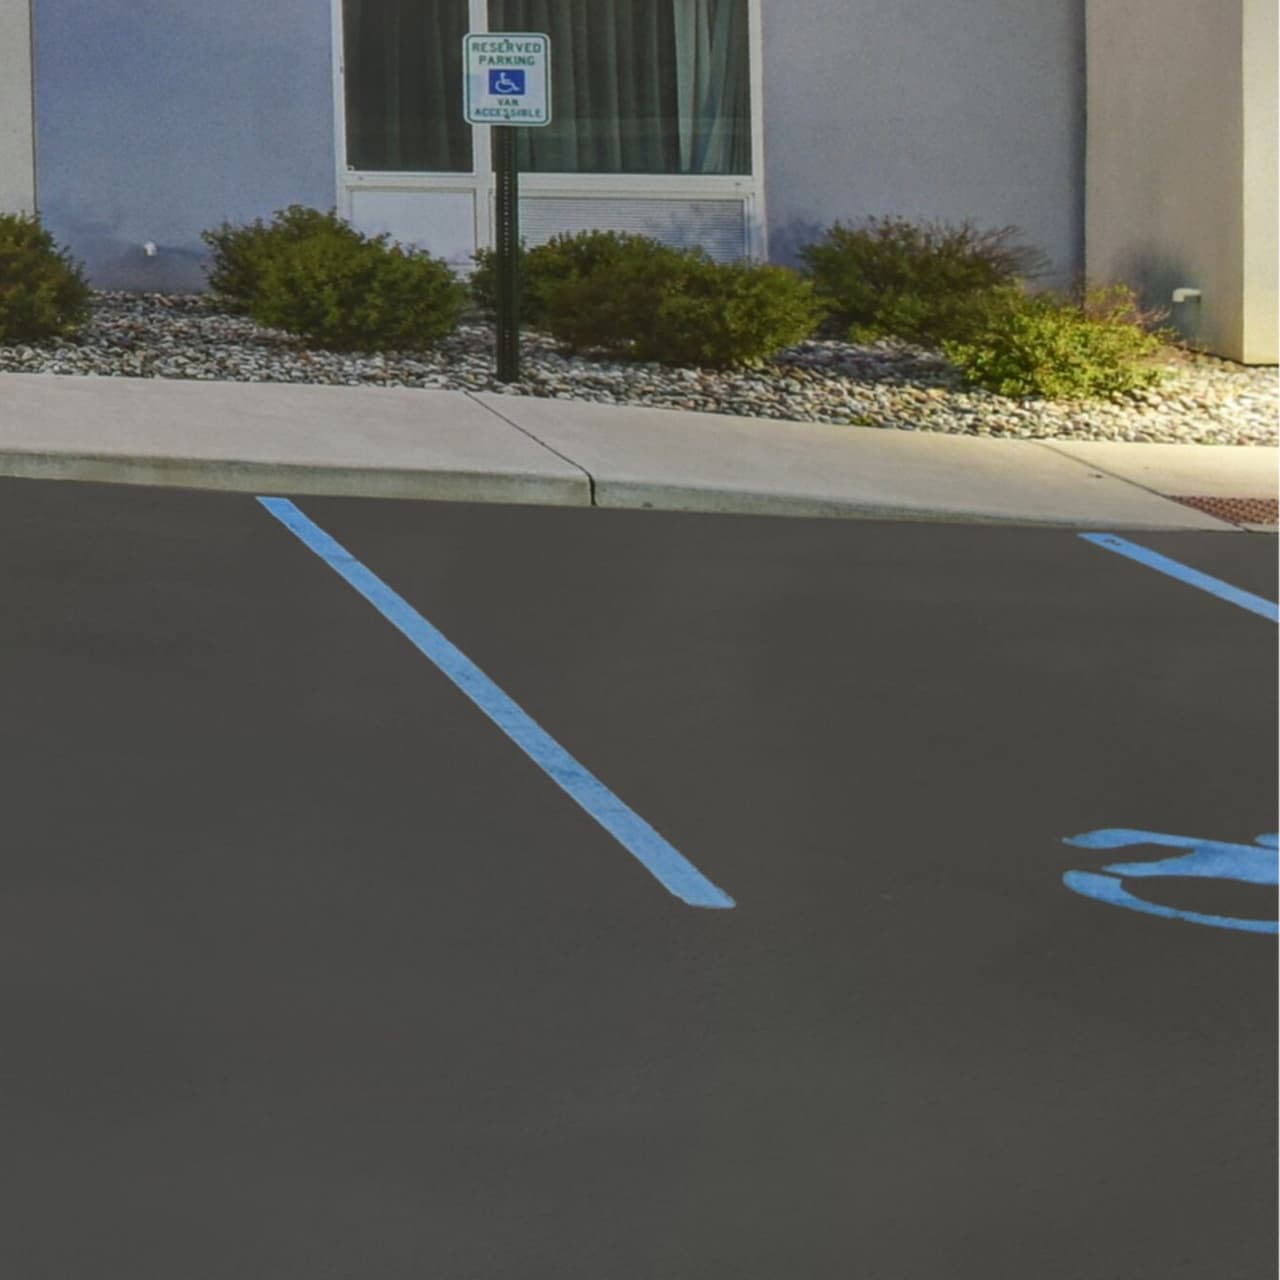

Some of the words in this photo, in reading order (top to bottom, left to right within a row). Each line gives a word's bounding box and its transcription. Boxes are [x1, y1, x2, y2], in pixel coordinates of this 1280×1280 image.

[471, 42, 542, 53] RESERVED
[479, 55, 535, 65] PARKING
[475, 108, 541, 118] ACCESSIBLE
